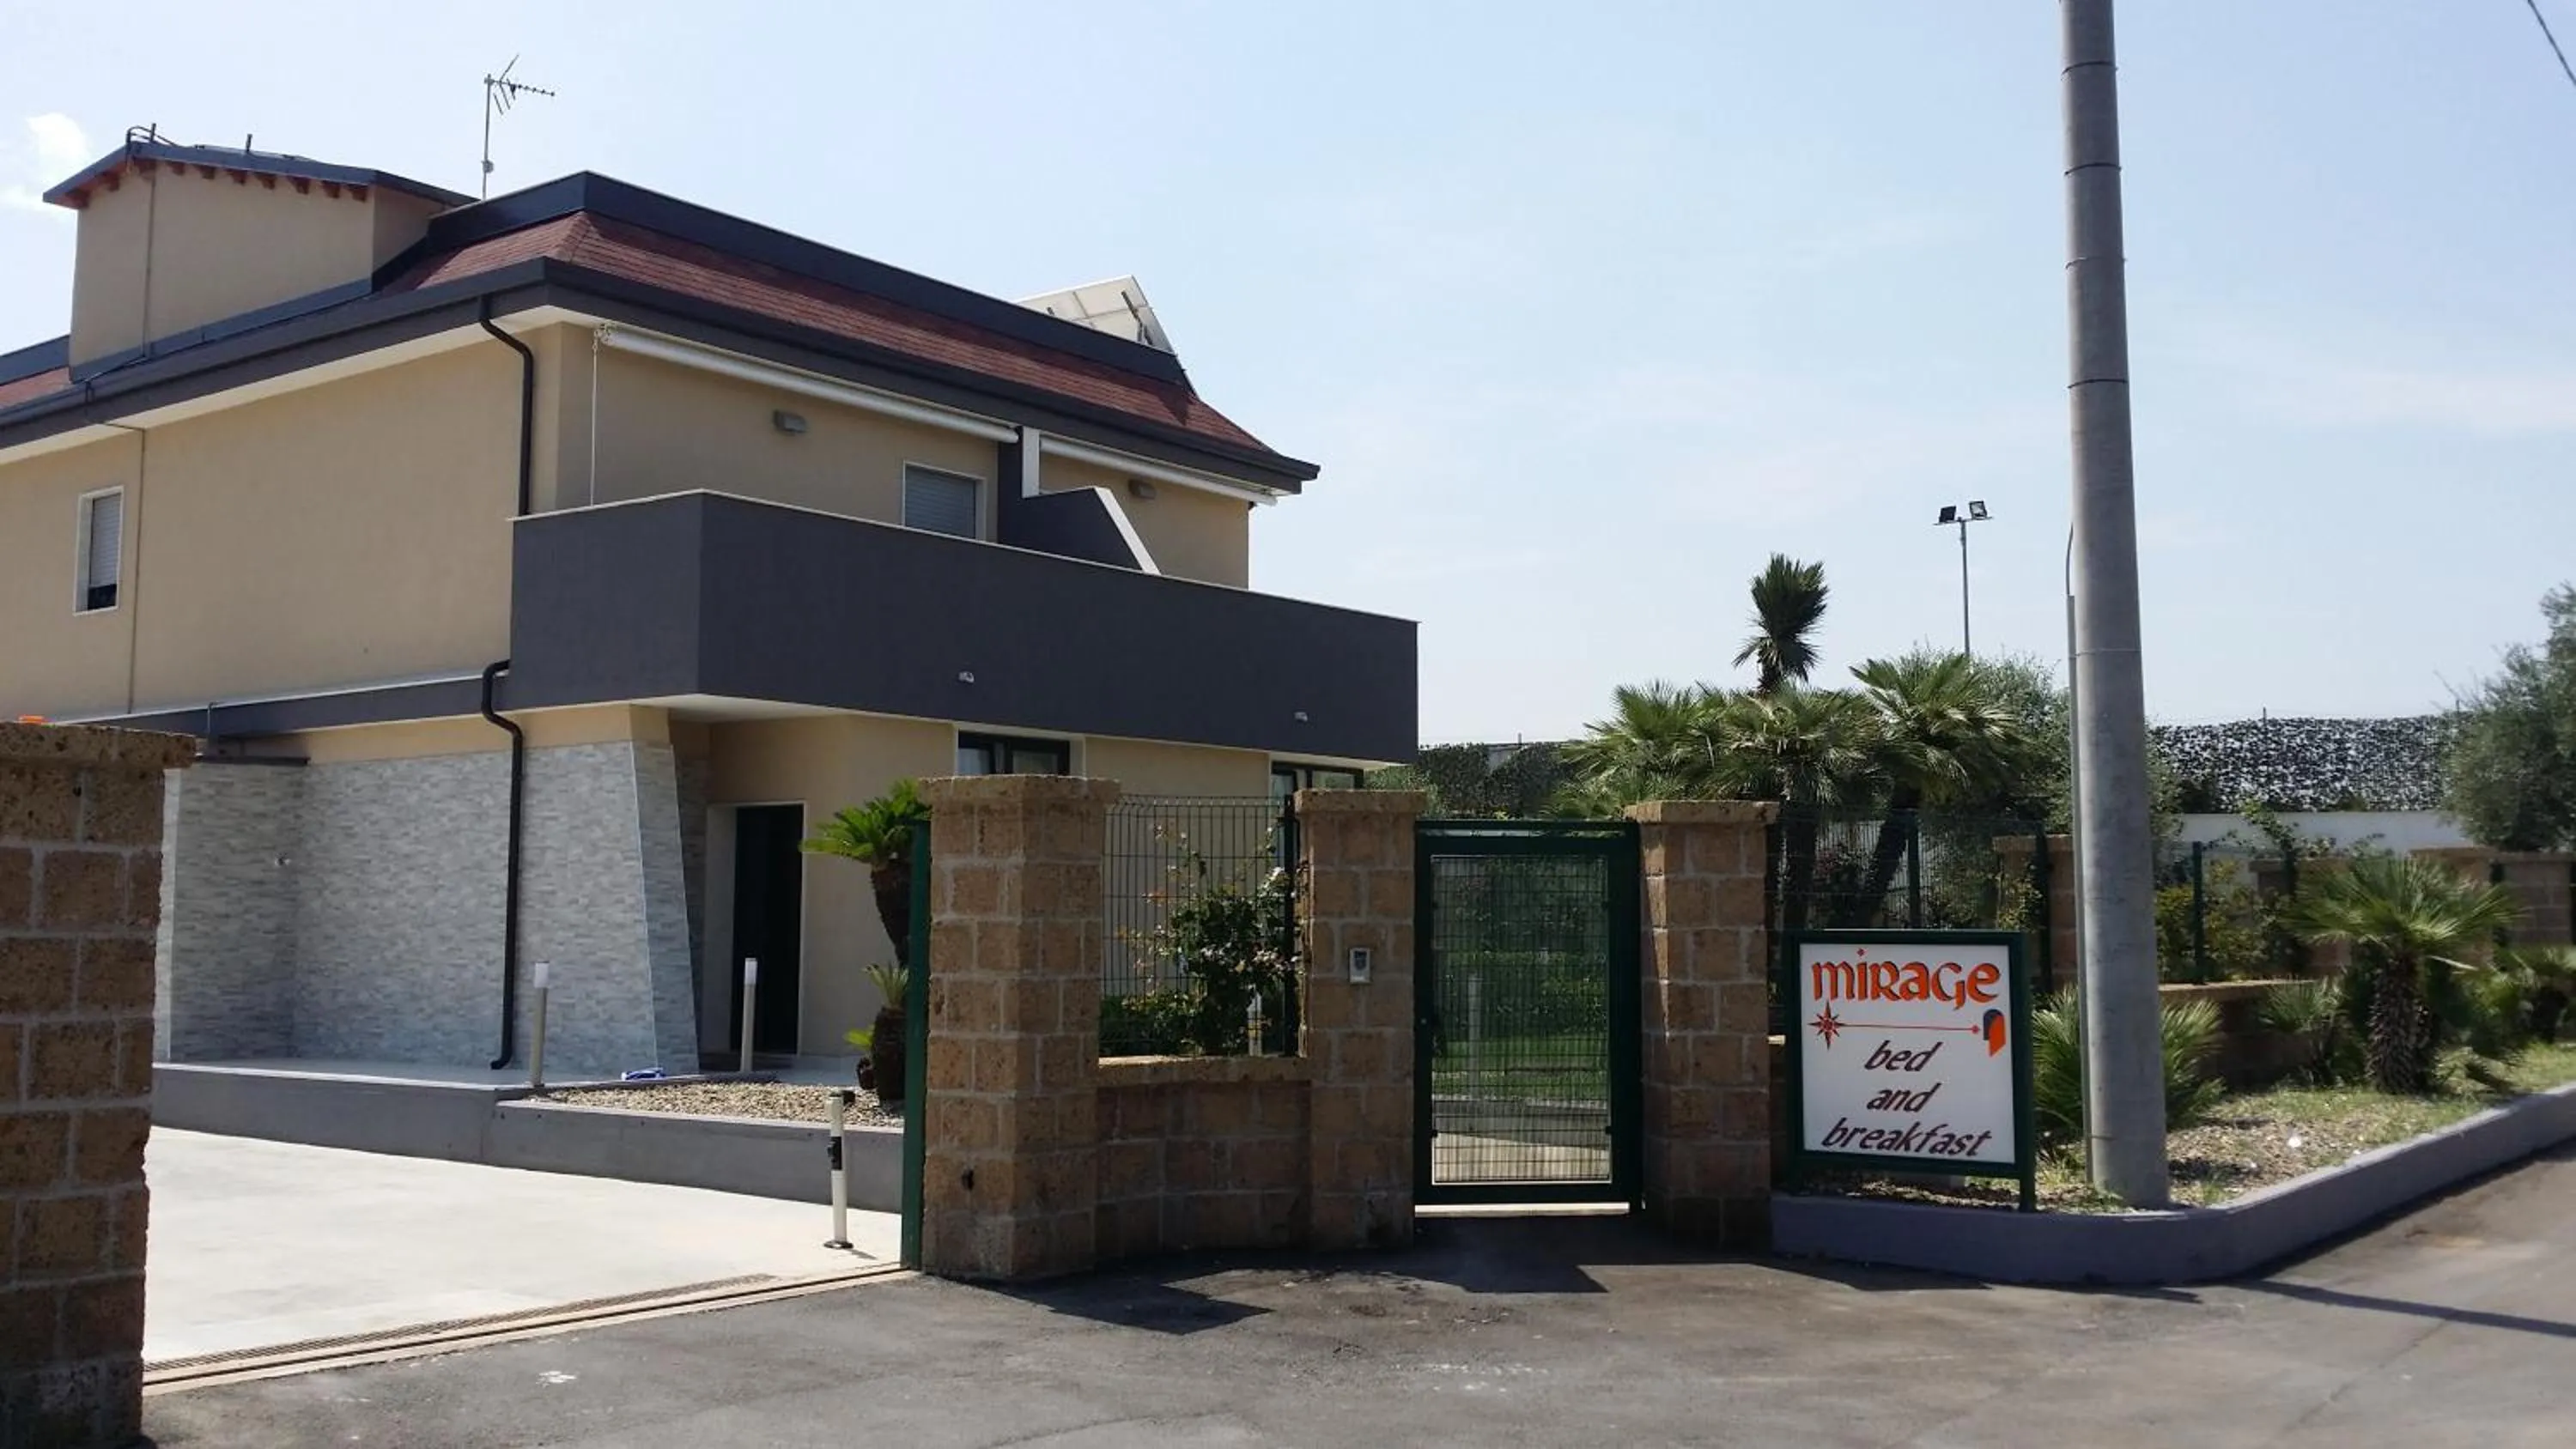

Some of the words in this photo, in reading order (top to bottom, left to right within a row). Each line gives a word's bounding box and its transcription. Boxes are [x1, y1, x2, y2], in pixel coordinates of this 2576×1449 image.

[1864, 1040, 1943, 1071] bed
[1866, 1082, 1941, 1113] and
[1821, 1118, 1992, 1156] breakfast
